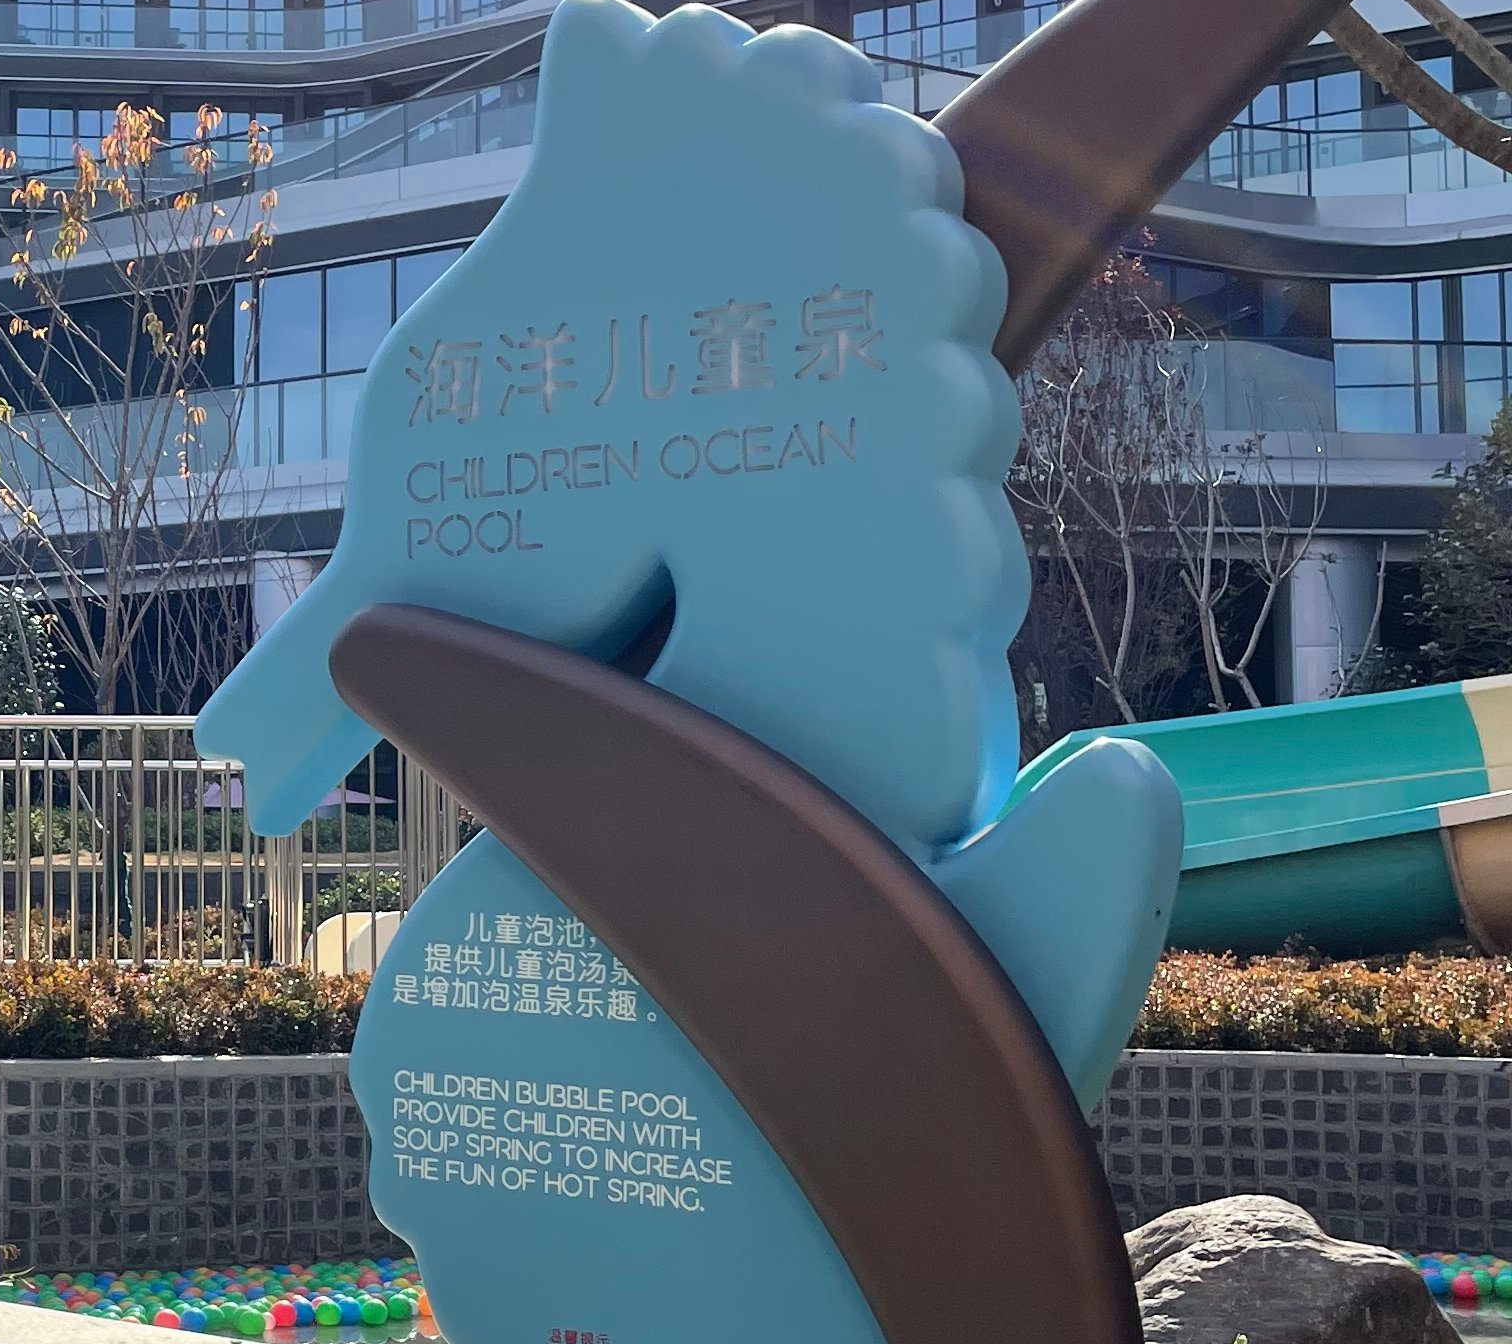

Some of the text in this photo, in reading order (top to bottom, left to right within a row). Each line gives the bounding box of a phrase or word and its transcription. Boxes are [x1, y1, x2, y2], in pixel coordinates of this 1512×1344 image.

[405, 284, 888, 428] 海洋儿童泉
[406, 416, 856, 503] CHILDREN OCEAN
[407, 510, 543, 559] POOL
[392, 974, 657, 1023] 是增加泡温泉乐趣。
[393, 1070, 697, 1121] CHILDREN BUBBLE POOL
[393, 1098, 701, 1151] PROVIDE CHILDREN WITH
[393, 1126, 732, 1186] SOUP SPRING TO INCREASE
[393, 1154, 705, 1213] THE FUN OF HOT SPRING.
